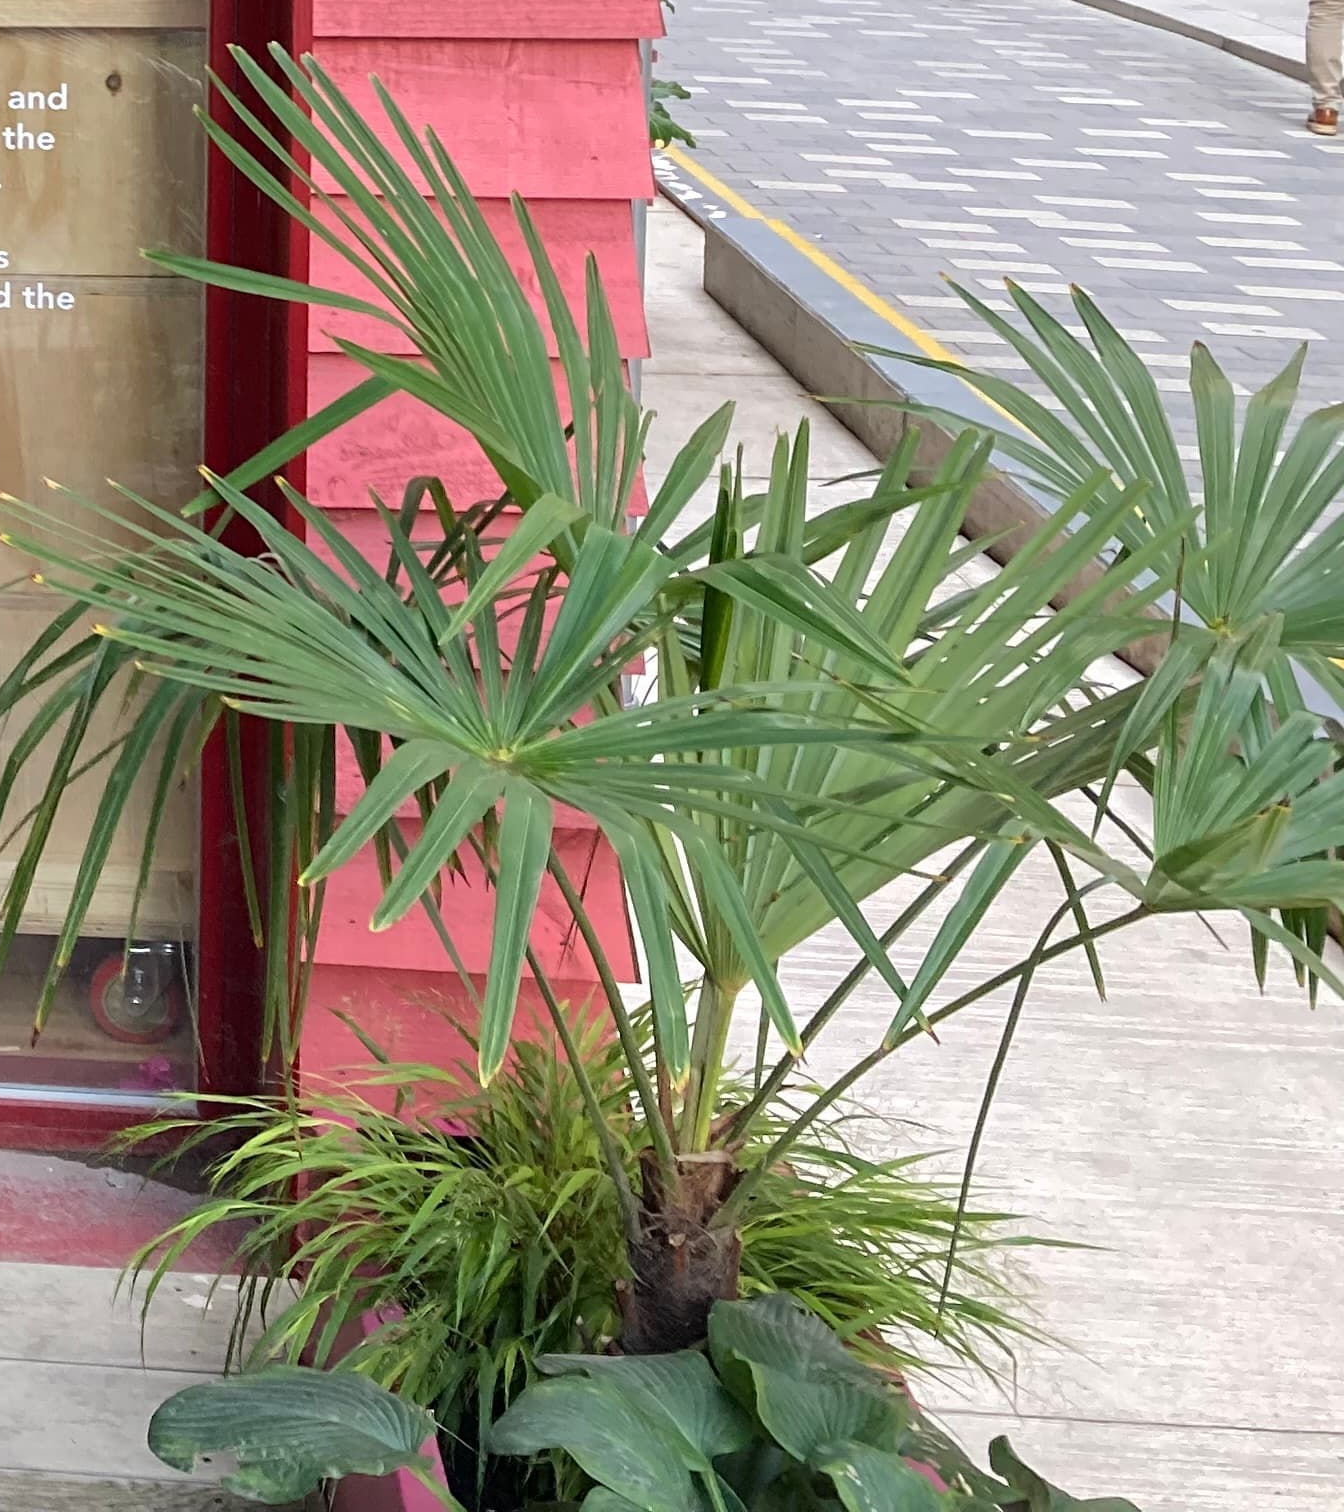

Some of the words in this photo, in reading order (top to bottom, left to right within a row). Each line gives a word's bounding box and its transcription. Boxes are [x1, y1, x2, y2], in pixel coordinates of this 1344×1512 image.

[7, 82, 68, 110] and
[1, 122, 56, 151] the
[21, 282, 75, 311] the
